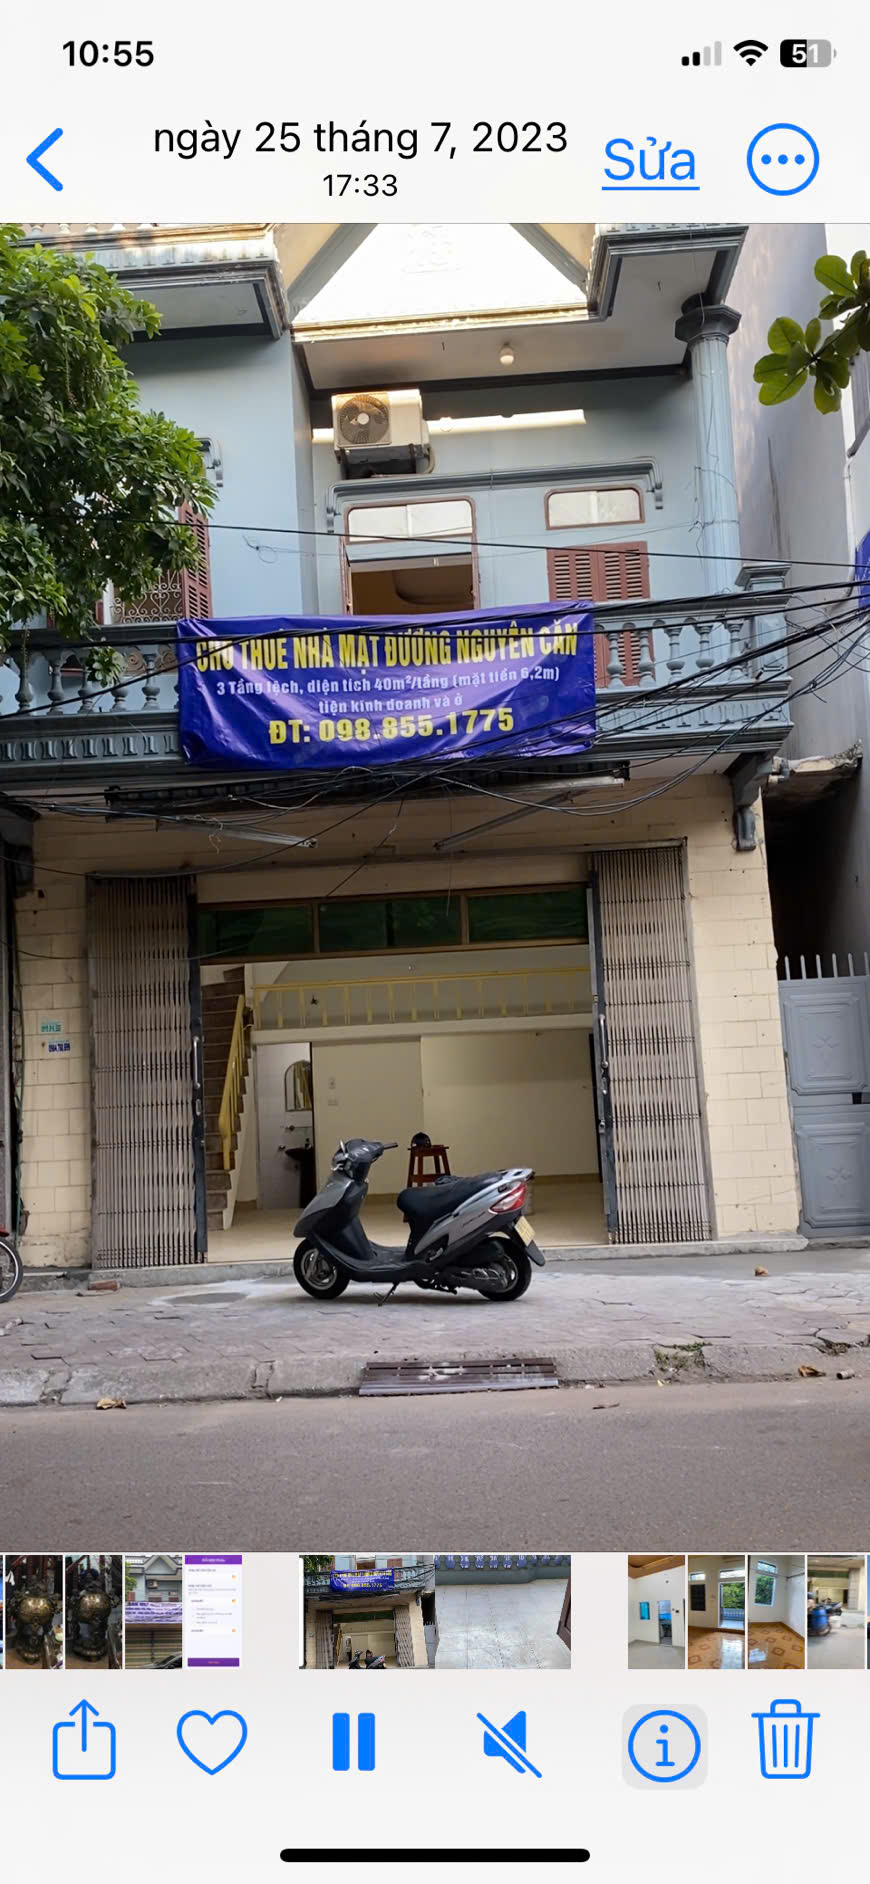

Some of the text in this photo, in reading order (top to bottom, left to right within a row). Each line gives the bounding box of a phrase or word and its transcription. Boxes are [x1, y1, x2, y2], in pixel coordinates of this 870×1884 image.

[63, 40, 154, 67] 10:55
[792, 43, 819, 64] 51
[154, 119, 567, 160] ngày 25 tháng 7, 2023
[604, 136, 696, 181] Sửa
[323, 174, 397, 197] 17:33
[196, 640, 234, 672] CHO
[456, 620, 535, 664] NGUYÊN
[540, 619, 578, 656] CĂN
[216, 681, 226, 696] 3
[266, 680, 303, 697] lệch,
[307, 679, 339, 696] diện
[342, 678, 371, 692] tích
[520, 665, 560, 682] 6,2m)
[318, 699, 347, 716] tiện
[351, 699, 382, 713] kinh
[386, 697, 430, 711] doanh
[434, 695, 450, 708] và
[268, 707, 514, 744] ĐT: 098.855.1775
